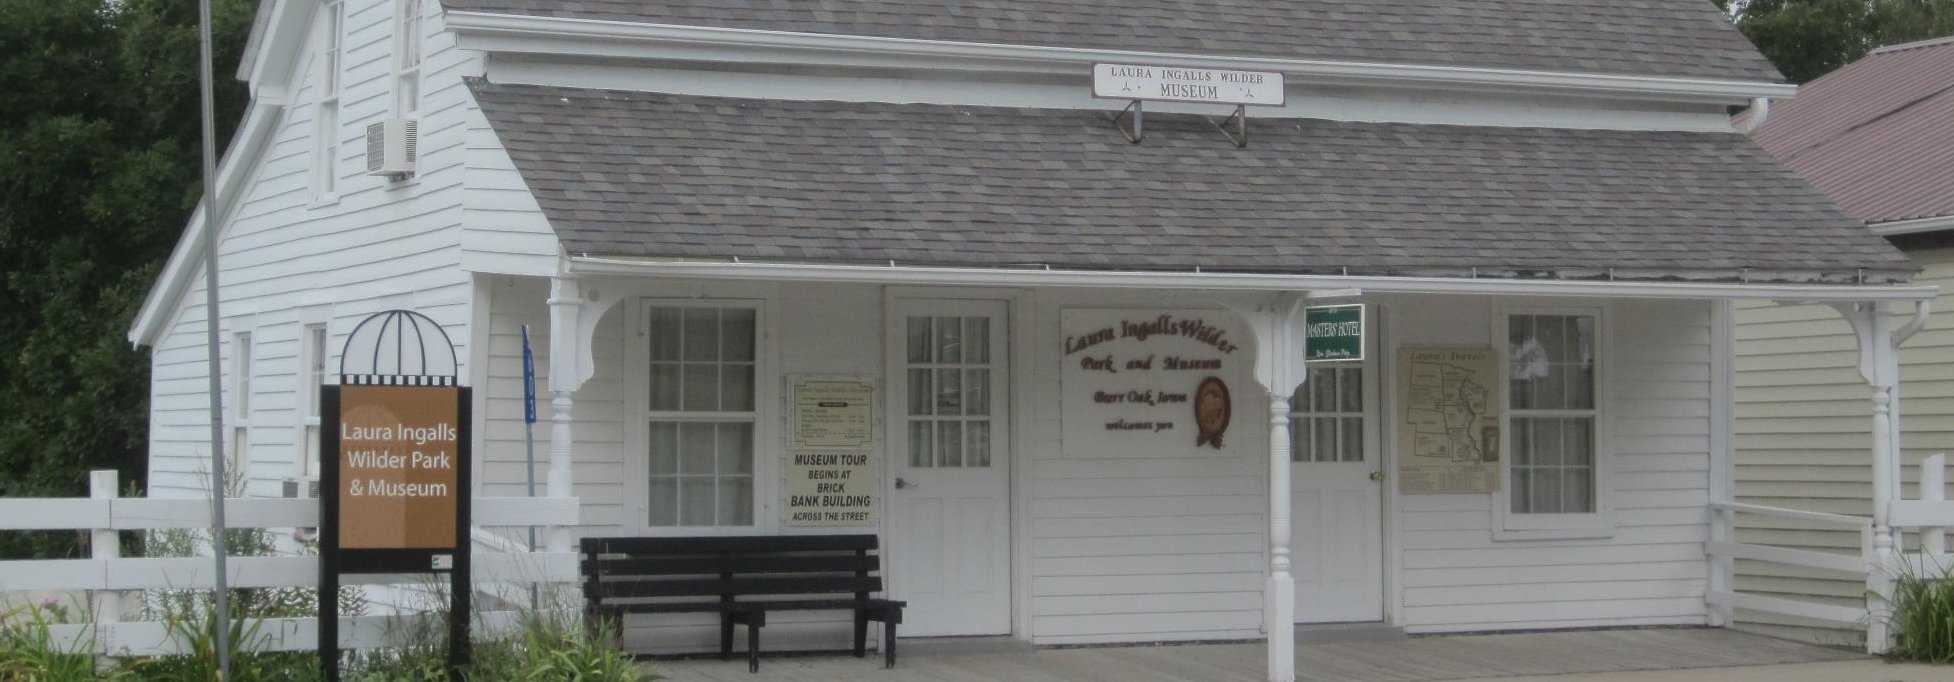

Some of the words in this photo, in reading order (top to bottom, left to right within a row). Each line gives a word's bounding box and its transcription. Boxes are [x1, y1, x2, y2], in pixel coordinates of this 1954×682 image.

[1111, 67, 1152, 78] LAURA
[1162, 70, 1212, 81] INGALLS
[1220, 73, 1264, 84] WILDER
[1160, 84, 1218, 99] MUSEUM
[1064, 328, 1116, 356] Laura
[1120, 315, 1178, 341] Ingalls
[1178, 320, 1239, 354] Wilder
[1338, 321, 1361, 337] HOTEL
[1080, 355, 1118, 373] Park
[1126, 354, 1156, 370] and
[1163, 357, 1222, 370] Museum
[1094, 391, 1126, 404] Burr
[342, 422, 393, 441] Laura
[397, 422, 457, 445] Ingalls
[1105, 419, 1154, 430] welcomes
[1153, 421, 1174, 433] you
[347, 450, 407, 469] Wilder
[412, 451, 451, 470] Park
[794, 454, 838, 466] MUSEUM
[840, 454, 867, 466] TOUR
[808, 470, 839, 480] BEGINS
[840, 470, 852, 480] AT
[350, 479, 363, 497] &
[368, 479, 447, 497] Museum
[817, 483, 845, 493] BRICK
[790, 495, 820, 507] BANK
[822, 495, 871, 507] BUILDING
[793, 512, 822, 521] ACROSS
[823, 512, 840, 521] THE
[841, 512, 869, 521] STREET
